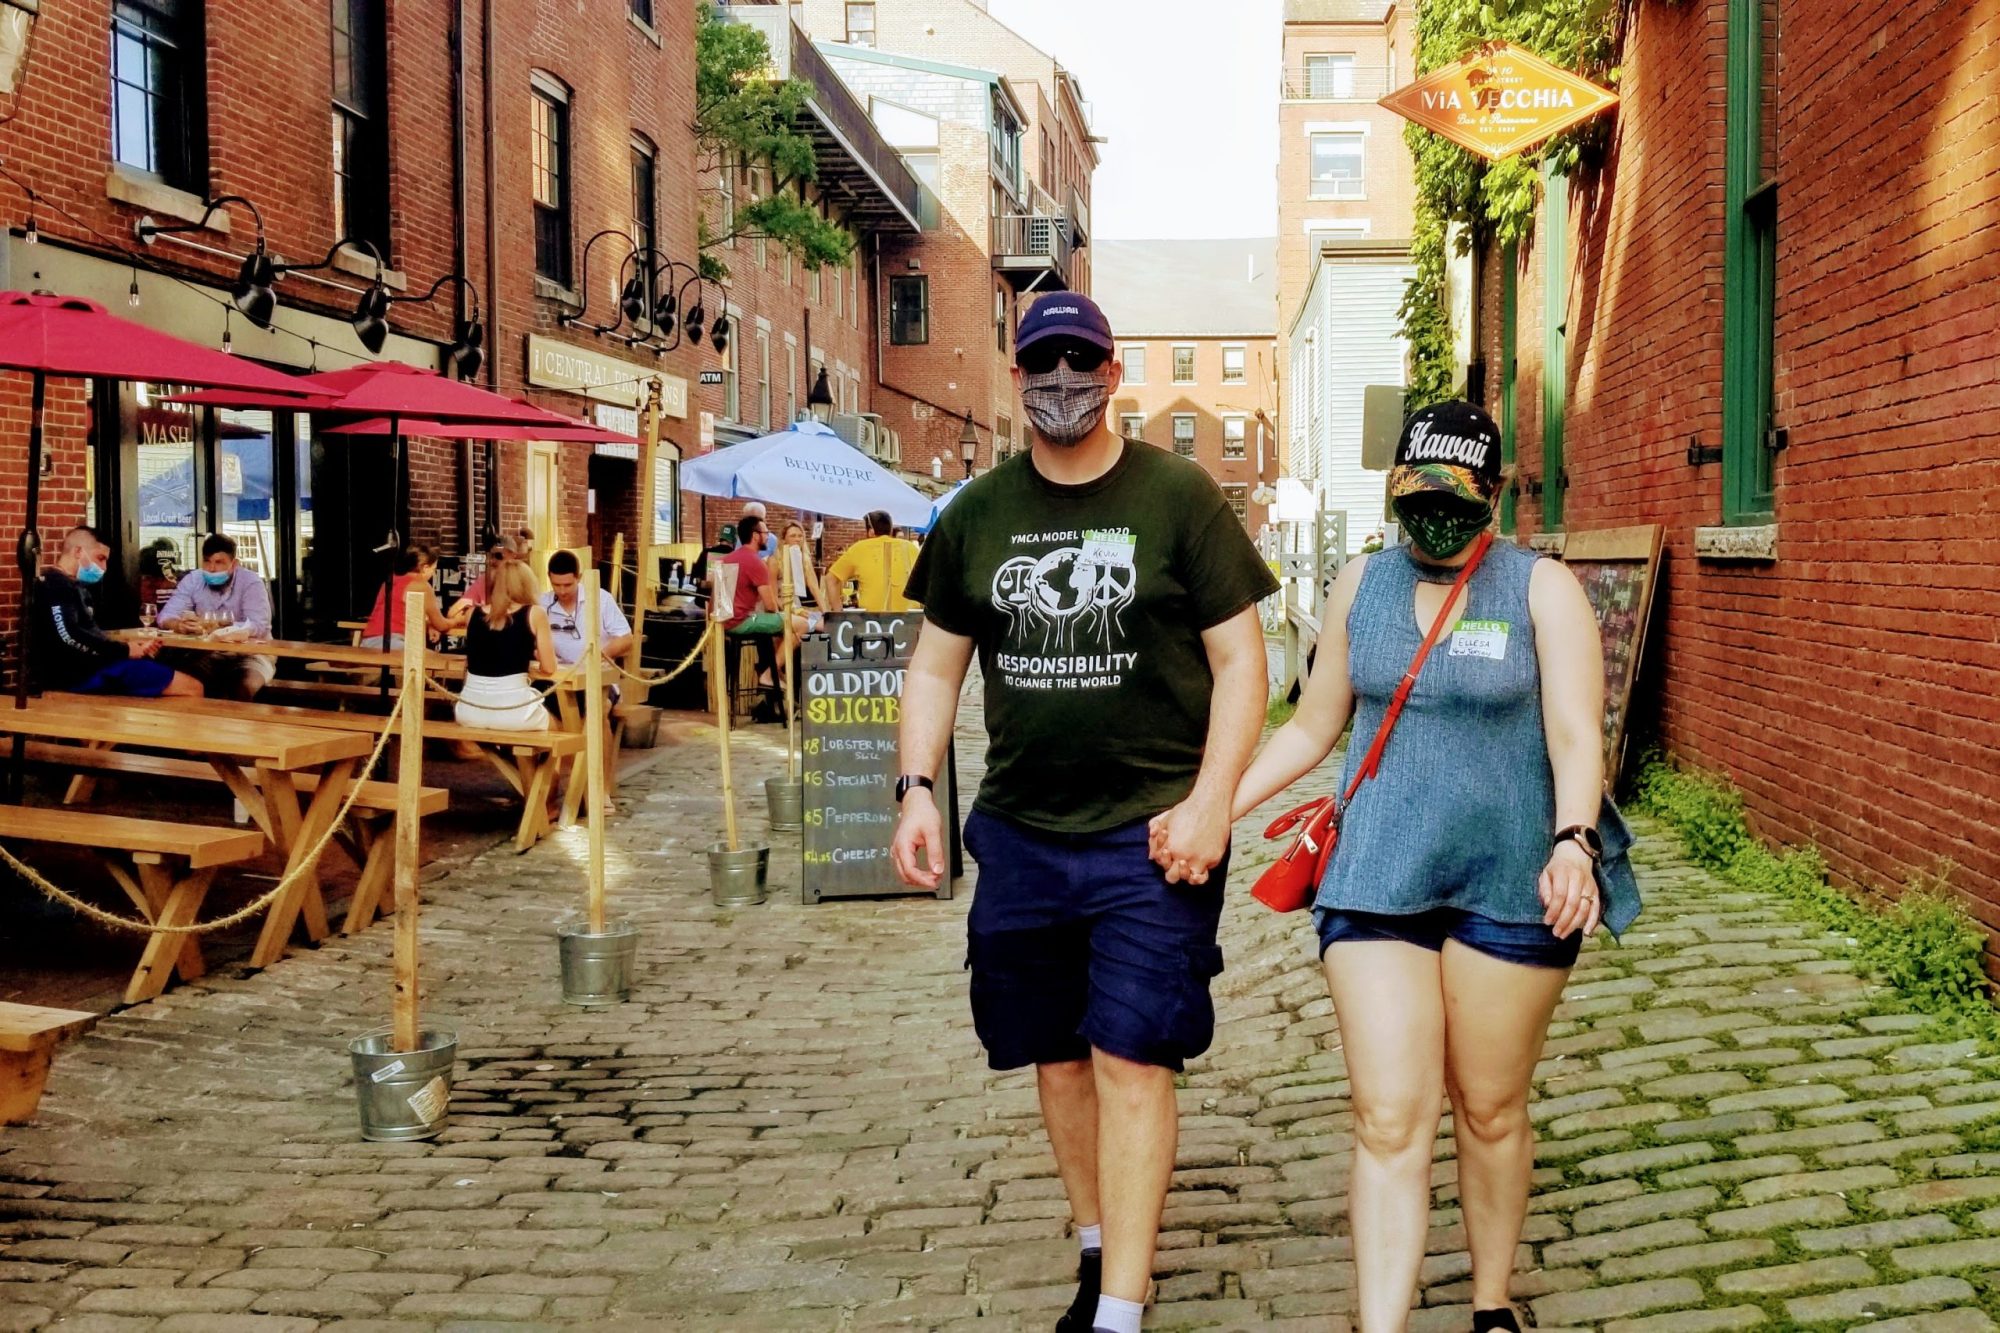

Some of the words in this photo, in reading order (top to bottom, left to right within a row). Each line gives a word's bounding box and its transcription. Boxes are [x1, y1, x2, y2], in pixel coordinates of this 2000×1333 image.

[545, 352, 607, 385] CENTRAL
[700, 373, 720, 382] ATM
[143, 421, 189, 446] MASH
[1405, 421, 1491, 468] Hawaii
[784, 456, 875, 482] BELVEDERE
[811, 474, 853, 486] VODKA
[1011, 533, 1040, 544] YMCA
[1041, 530, 1078, 542] MODEL
[997, 652, 1137, 674] RESPONSIBILITY
[1005, 675, 1014, 686] TO
[1015, 677, 1053, 689] CHANGE
[1055, 678, 1077, 688] THE
[1080, 675, 1121, 688] WORLD
[822, 736, 874, 753] LOBSTER
[832, 848, 878, 864] CHEESE
